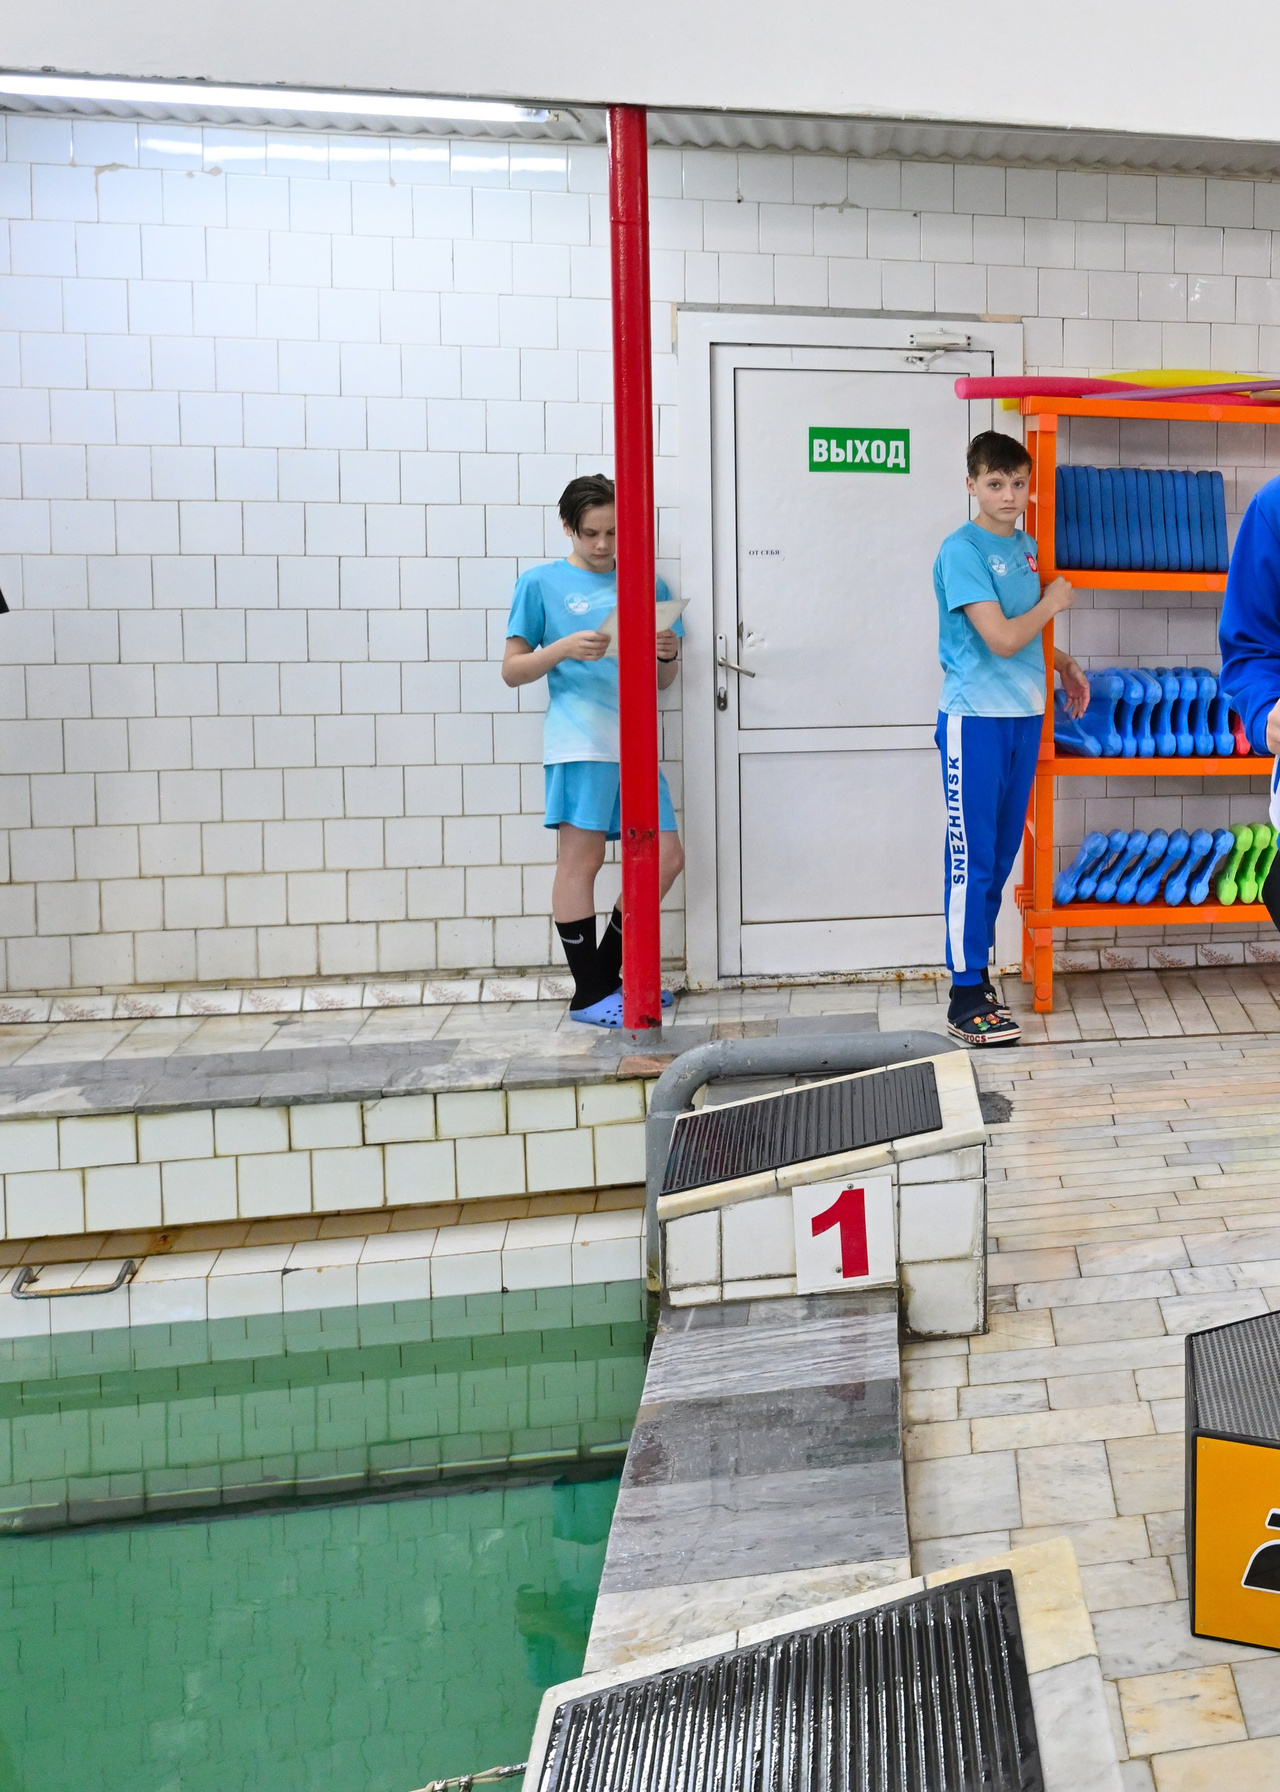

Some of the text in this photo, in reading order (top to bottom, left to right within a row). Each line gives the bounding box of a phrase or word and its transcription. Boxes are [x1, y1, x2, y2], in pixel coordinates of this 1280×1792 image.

[813, 439, 906, 468] ВЫХОД
[949, 755, 965, 885] SNEZHINSK
[811, 1187, 869, 1279] 1
